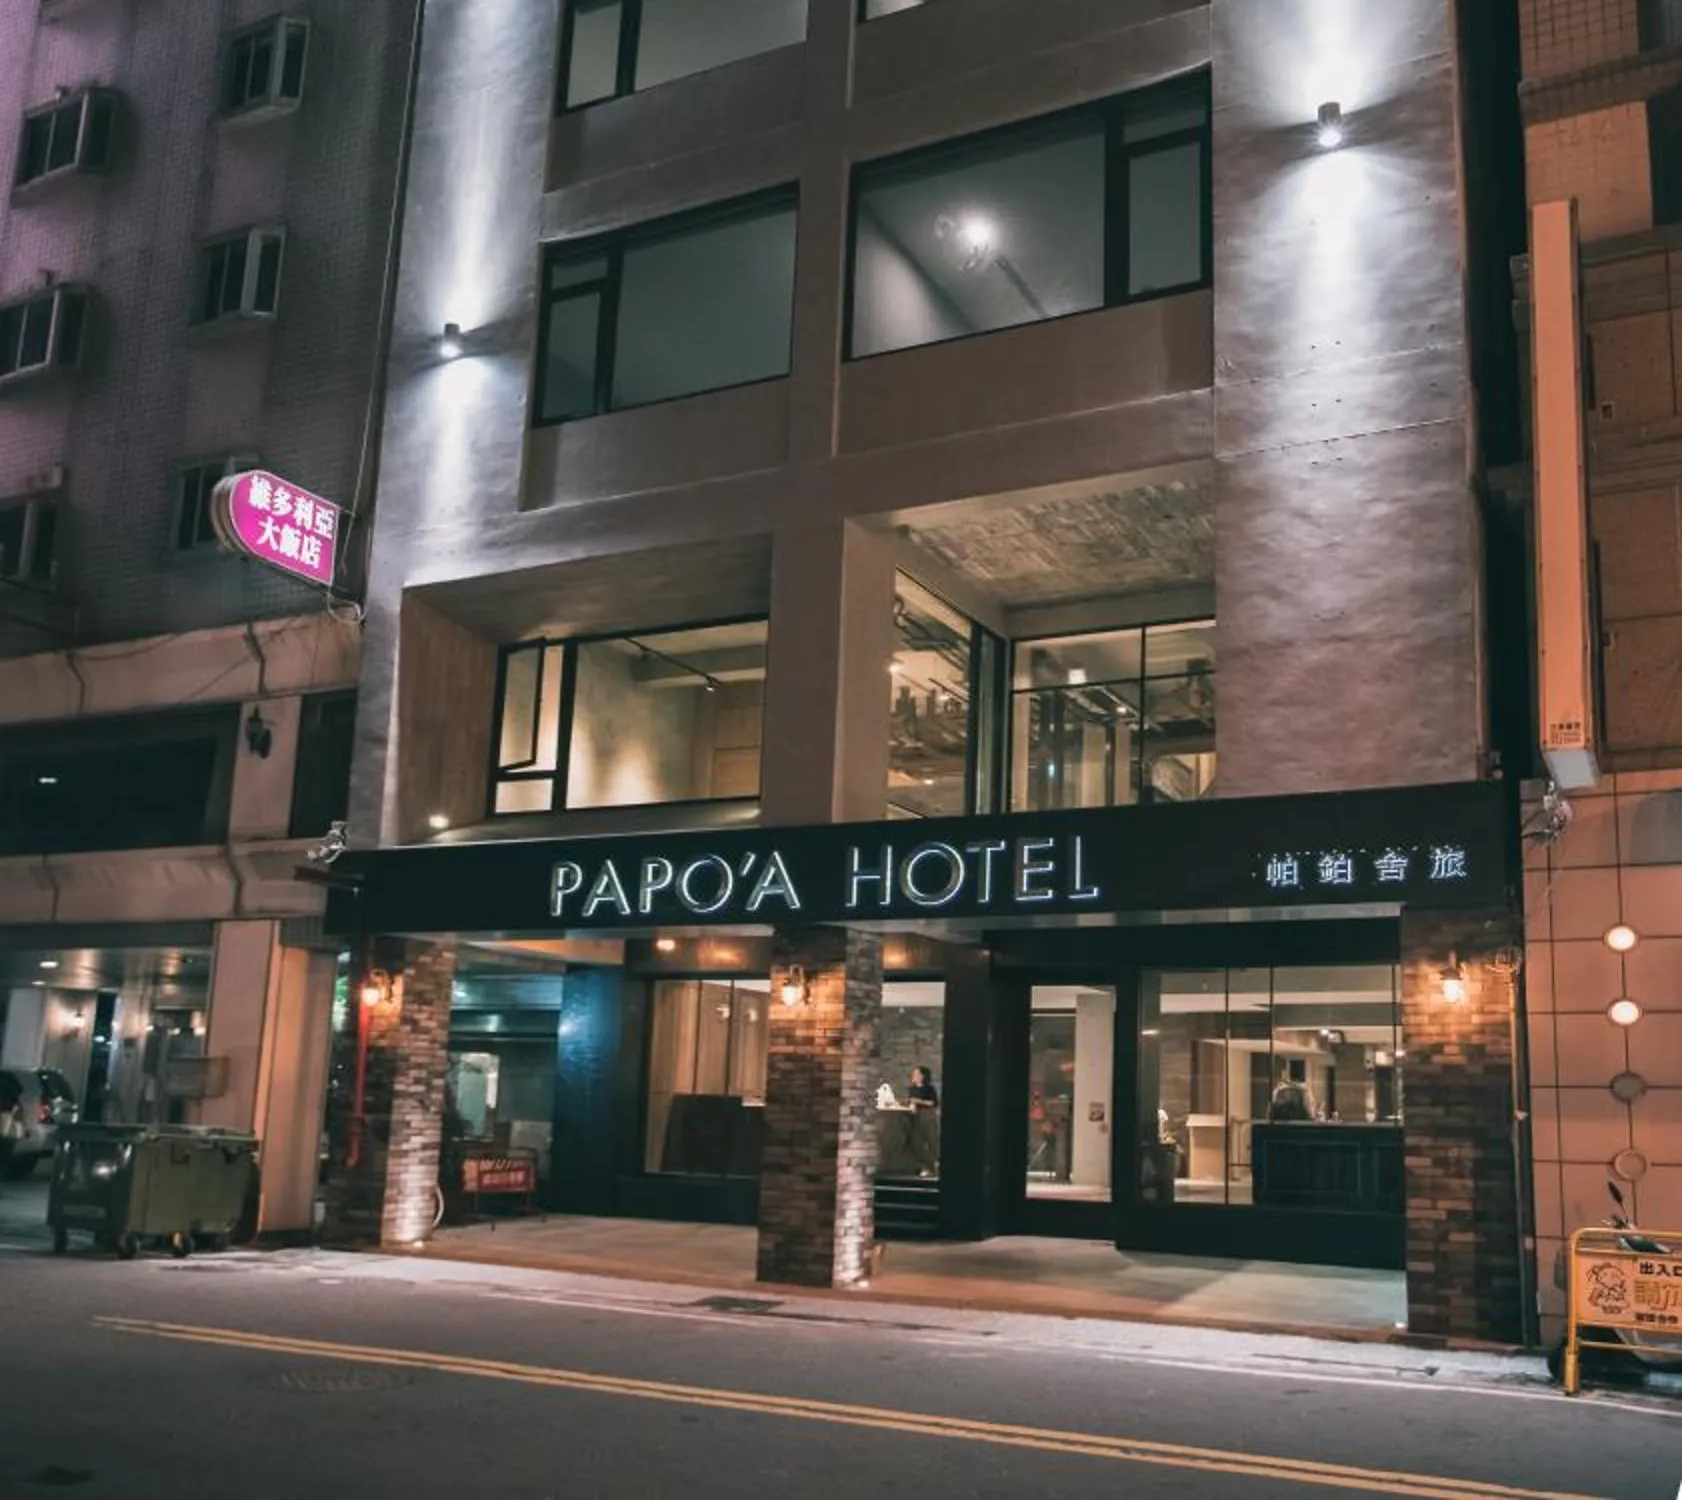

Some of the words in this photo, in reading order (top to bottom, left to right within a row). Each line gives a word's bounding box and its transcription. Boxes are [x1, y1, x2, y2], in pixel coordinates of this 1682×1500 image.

[256, 515, 322, 569] 大飯店
[550, 850, 801, 917] PAPO'A
[845, 835, 1100, 908] HOTEL
